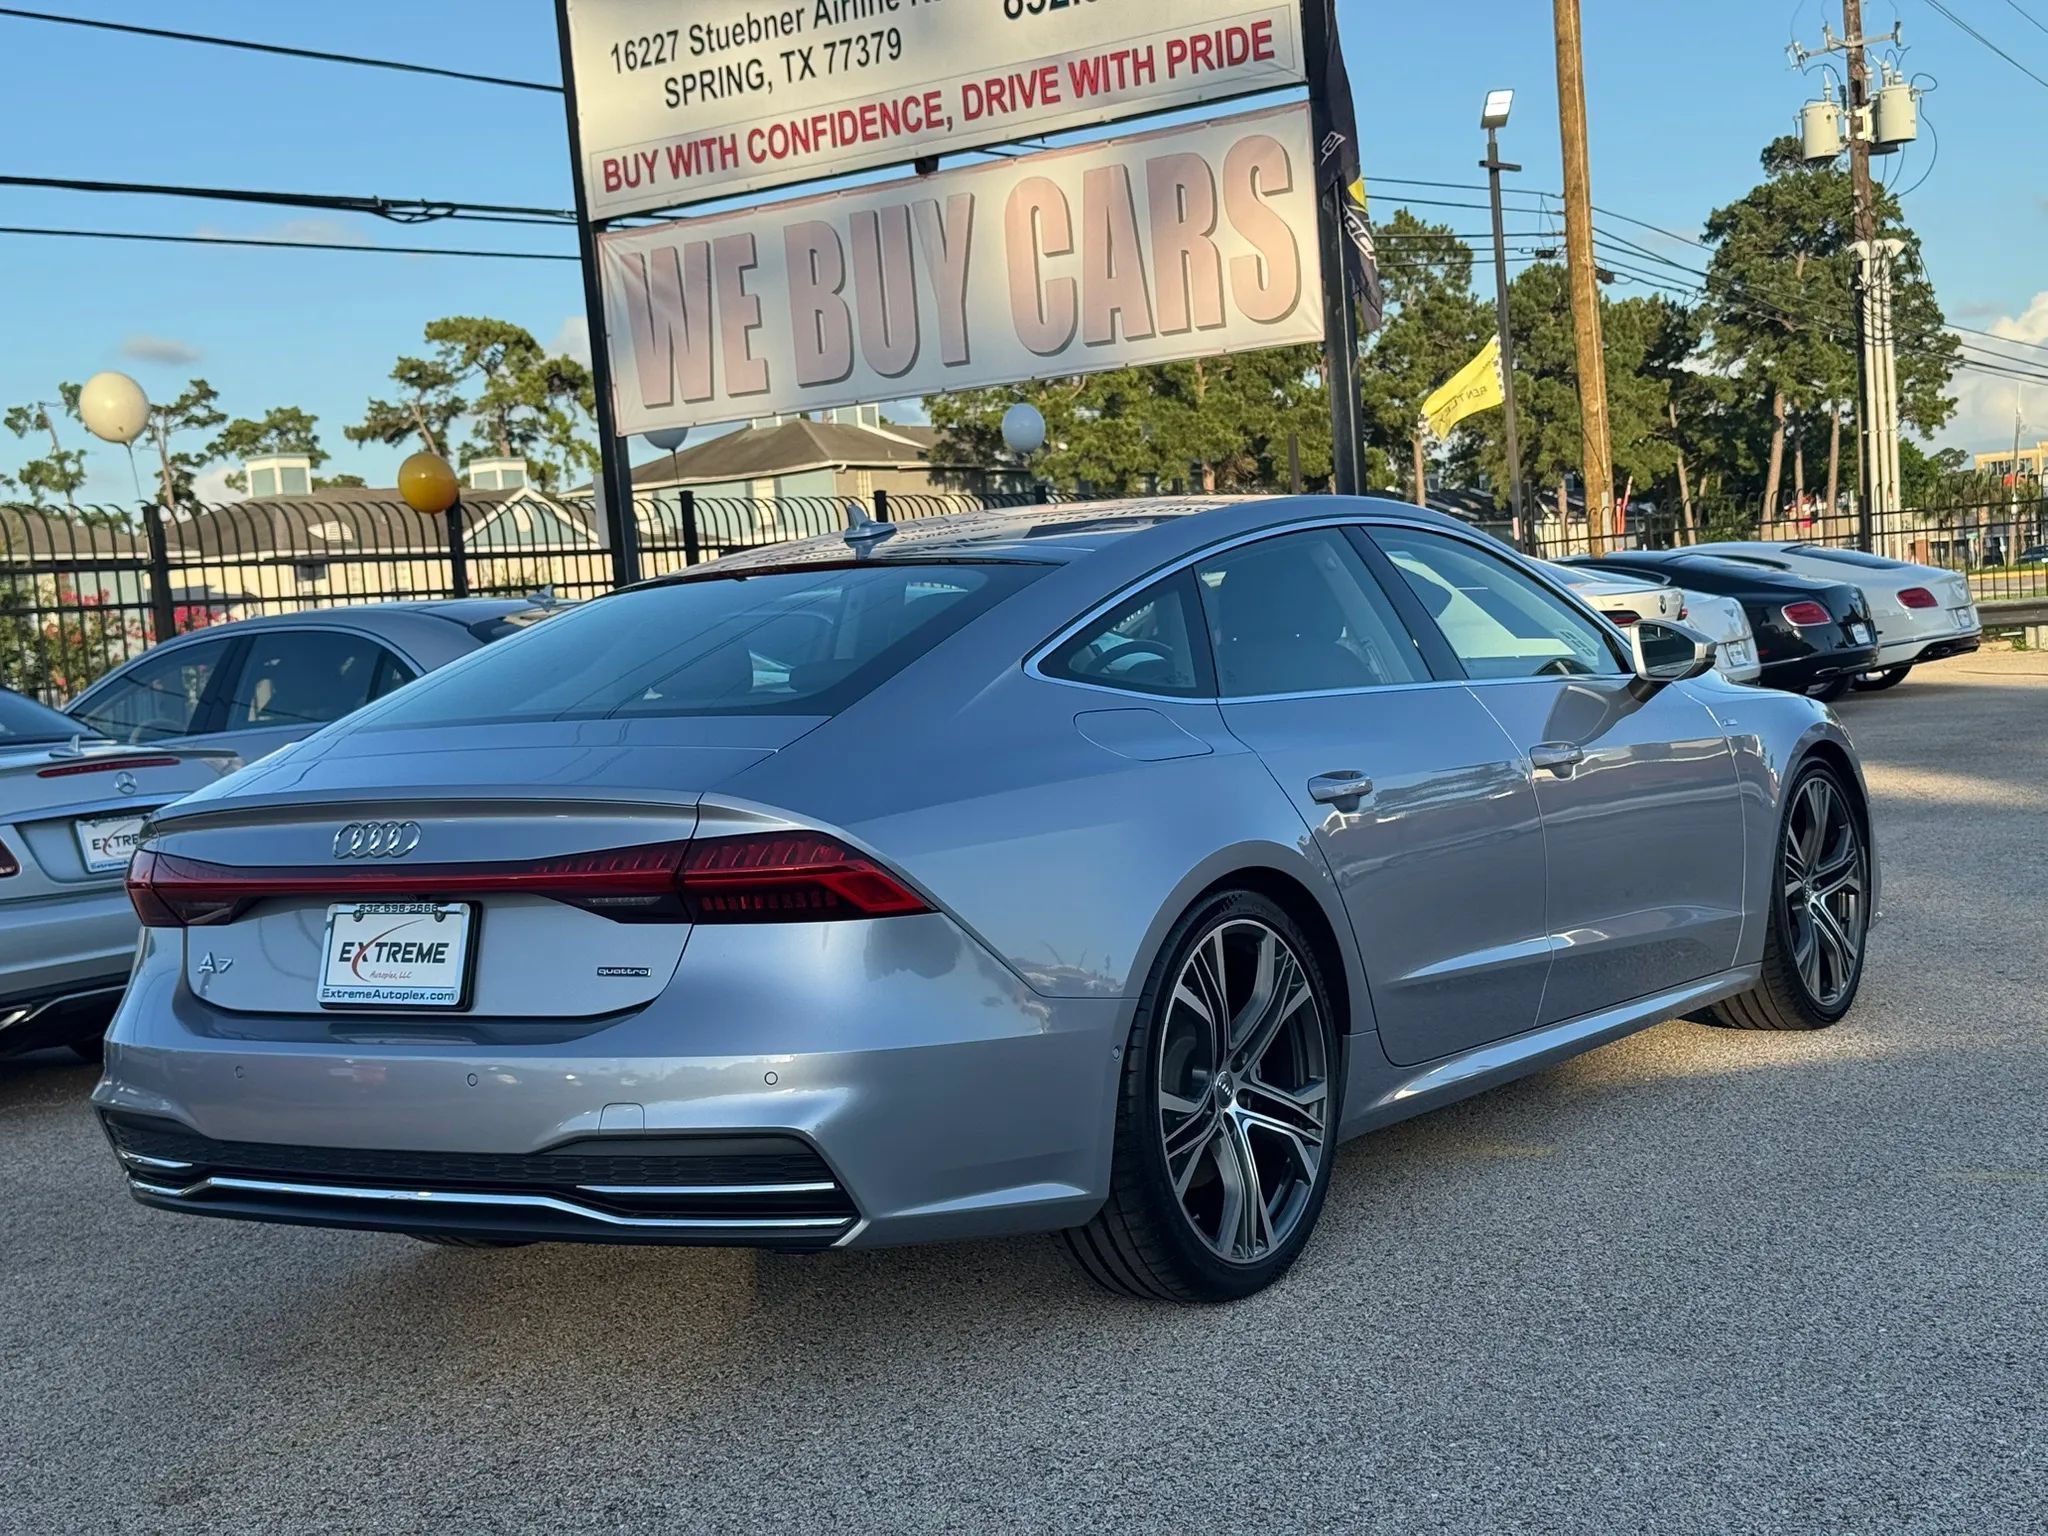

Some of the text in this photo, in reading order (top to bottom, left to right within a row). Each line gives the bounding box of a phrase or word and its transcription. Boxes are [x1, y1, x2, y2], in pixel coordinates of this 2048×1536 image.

[611, 30, 679, 74] 16227
[689, 8, 805, 55] Stuebner
[665, 27, 902, 109] SPRING, TX 77379
[603, 20, 1276, 193] BUY WITH CONFIDENCE, DRIVE WITH PRIDE
[620, 134, 1302, 408] WE BUY CARS
[197, 951, 234, 974] A7
[338, 941, 450, 964] EXTREME
[598, 967, 648, 976] quattro
[322, 988, 455, 1002] ExtremeAutoplex.com
